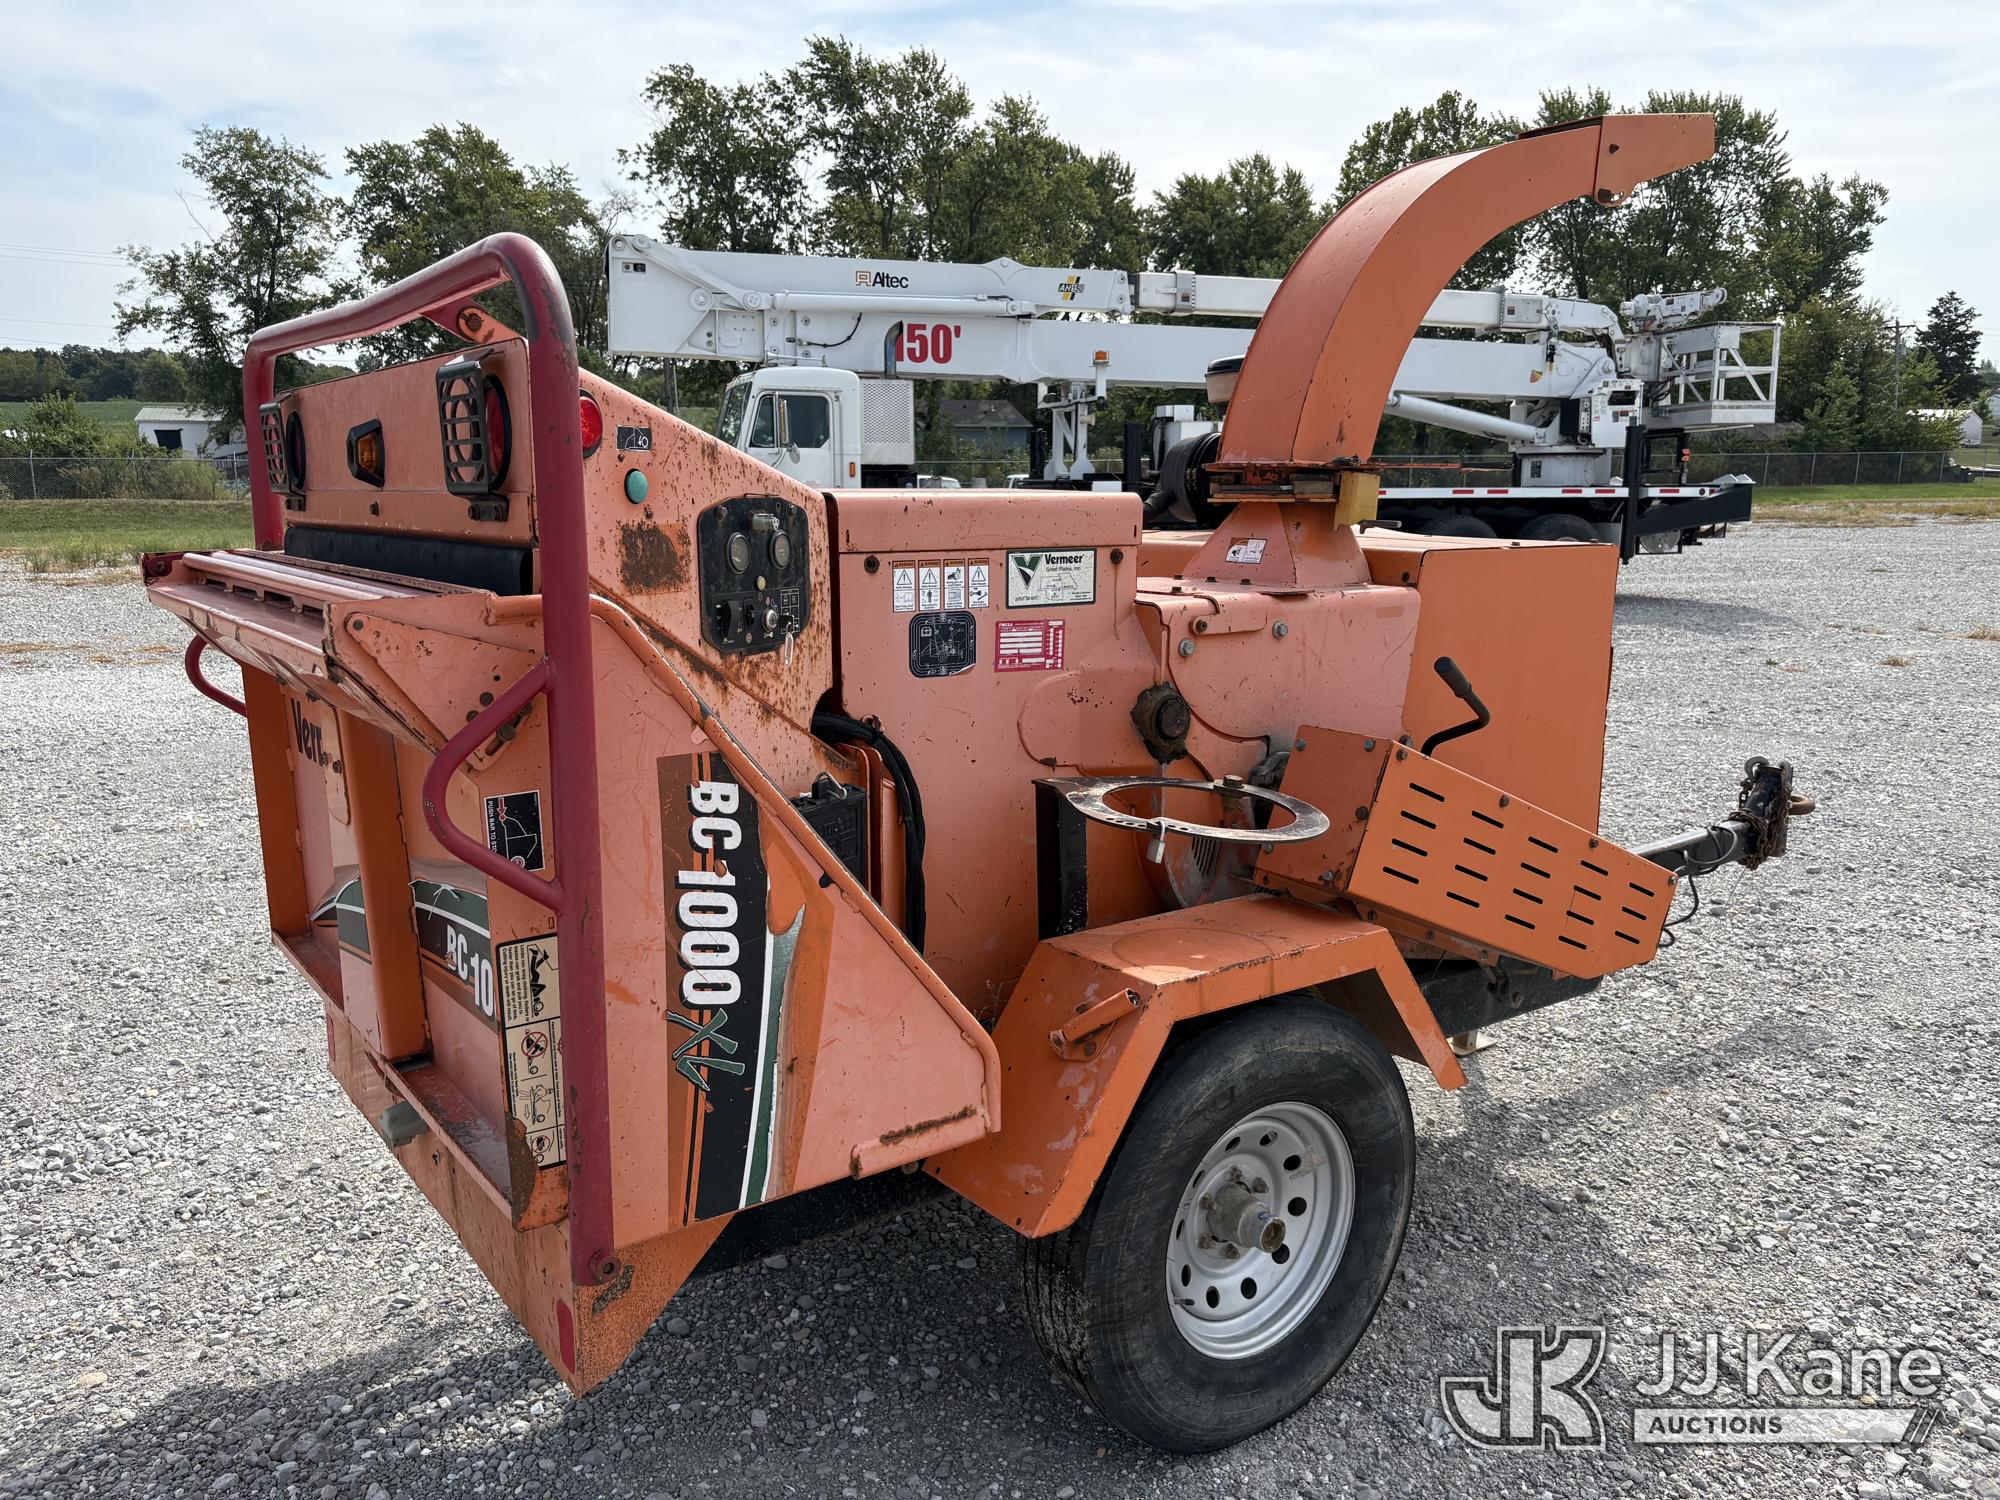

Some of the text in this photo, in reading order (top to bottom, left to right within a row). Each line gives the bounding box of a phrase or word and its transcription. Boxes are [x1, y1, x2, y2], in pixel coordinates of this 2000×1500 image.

[872, 271, 909, 289] Altec
[1045, 554, 1083, 565] Vermeer
[446, 923, 468, 981] BC
[665, 1007, 746, 1092] XL
